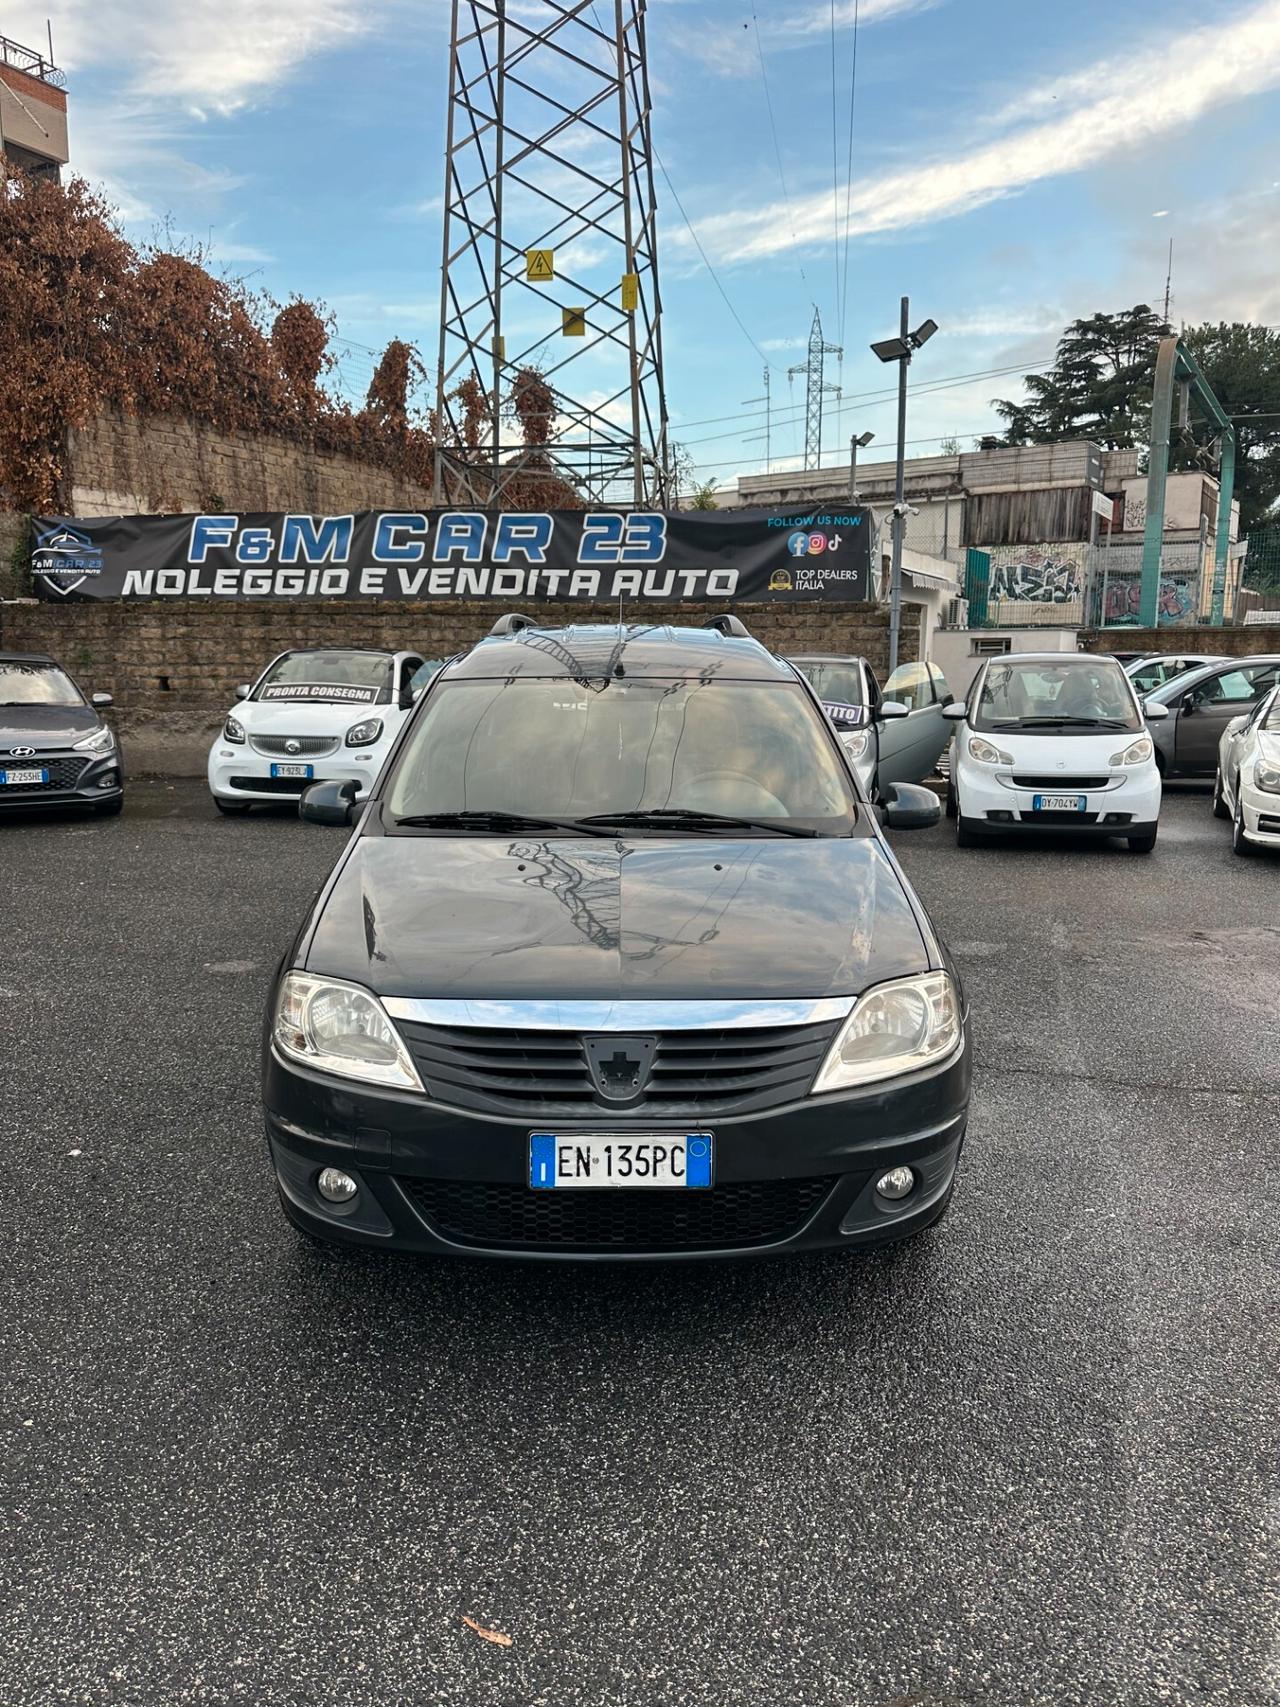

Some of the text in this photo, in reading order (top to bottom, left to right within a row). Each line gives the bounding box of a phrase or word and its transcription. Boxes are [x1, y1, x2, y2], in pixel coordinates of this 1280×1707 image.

[767, 516, 861, 527] FOLLOW US NOW
[187, 513, 667, 563] F&M CAR 23
[796, 570, 816, 580] TOP
[817, 570, 858, 580] DEALERS
[121, 569, 350, 596] NOLEGGIO
[359, 567, 389, 594] E
[398, 568, 602, 596] VENDITA
[609, 568, 741, 596] AUTO
[795, 580, 824, 590] ITALIA
[266, 686, 372, 700] PRONTA CONSEGNA
